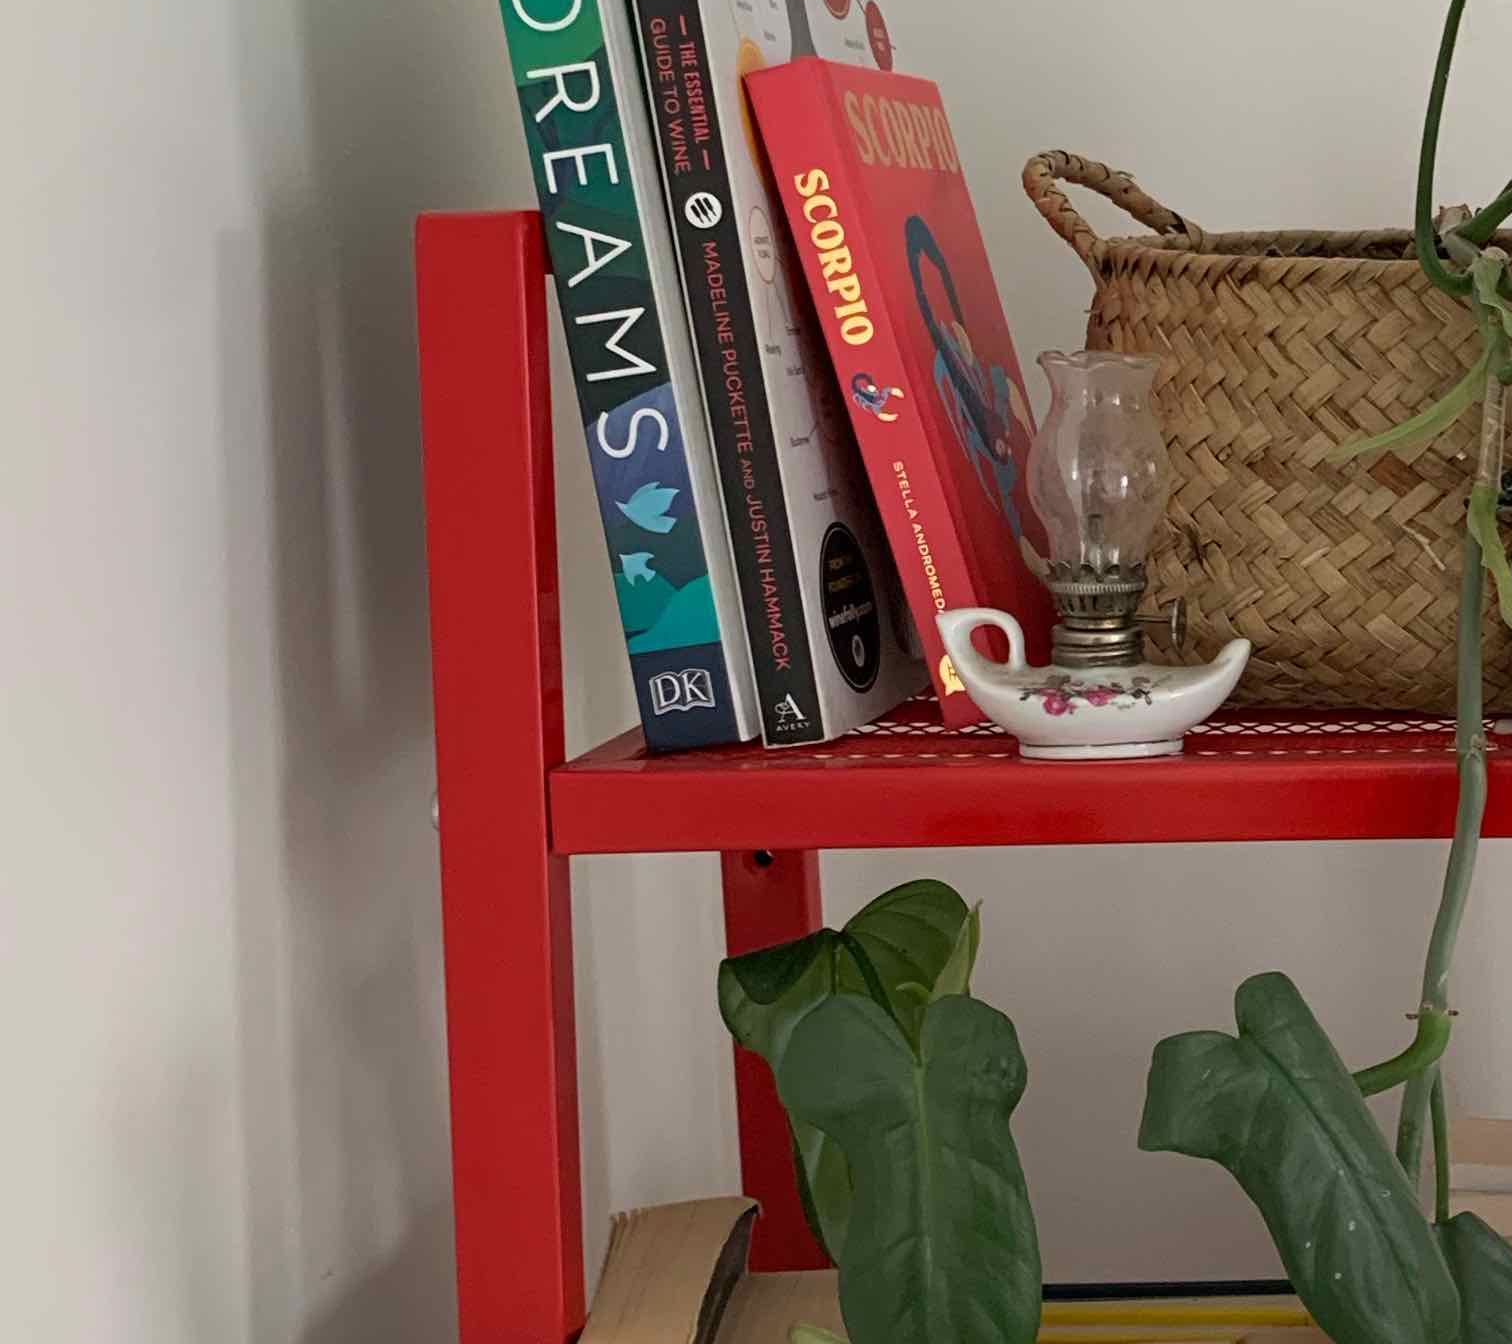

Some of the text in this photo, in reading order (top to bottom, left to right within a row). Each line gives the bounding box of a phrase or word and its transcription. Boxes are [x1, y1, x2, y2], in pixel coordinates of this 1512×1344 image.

[650, 17, 692, 177] GUIDE TO WINE
[679, 40, 711, 145] THE ESSENTIAL
[843, 89, 960, 174] SCORPIO
[793, 168, 876, 348] SCORPIO
[704, 239, 793, 672] MADELINE PUCKETTE AND JUSTIN HAMMACK
[892, 460, 947, 615] STELLA ANDROMED
[655, 671, 709, 708] DK
